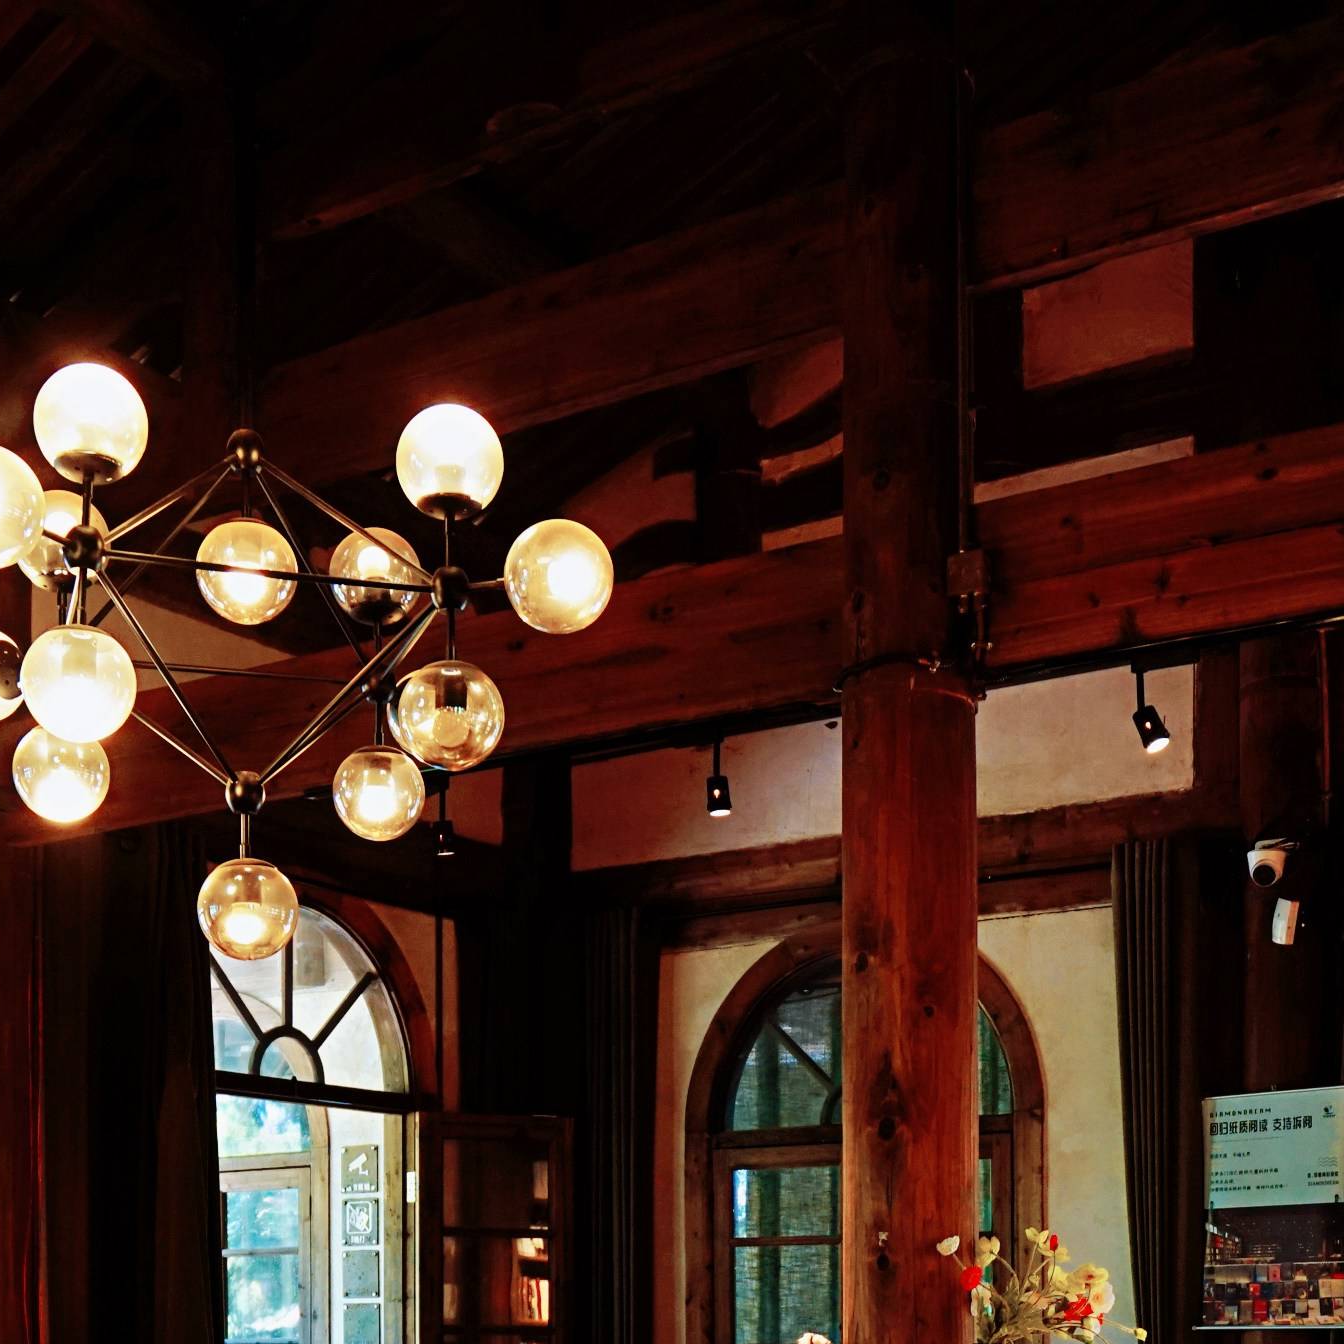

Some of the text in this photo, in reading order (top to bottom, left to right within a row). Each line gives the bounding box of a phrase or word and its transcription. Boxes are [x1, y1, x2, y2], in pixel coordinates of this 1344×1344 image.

[1209, 1115, 1313, 1137] 回归纸质阅读 支持拆阅
